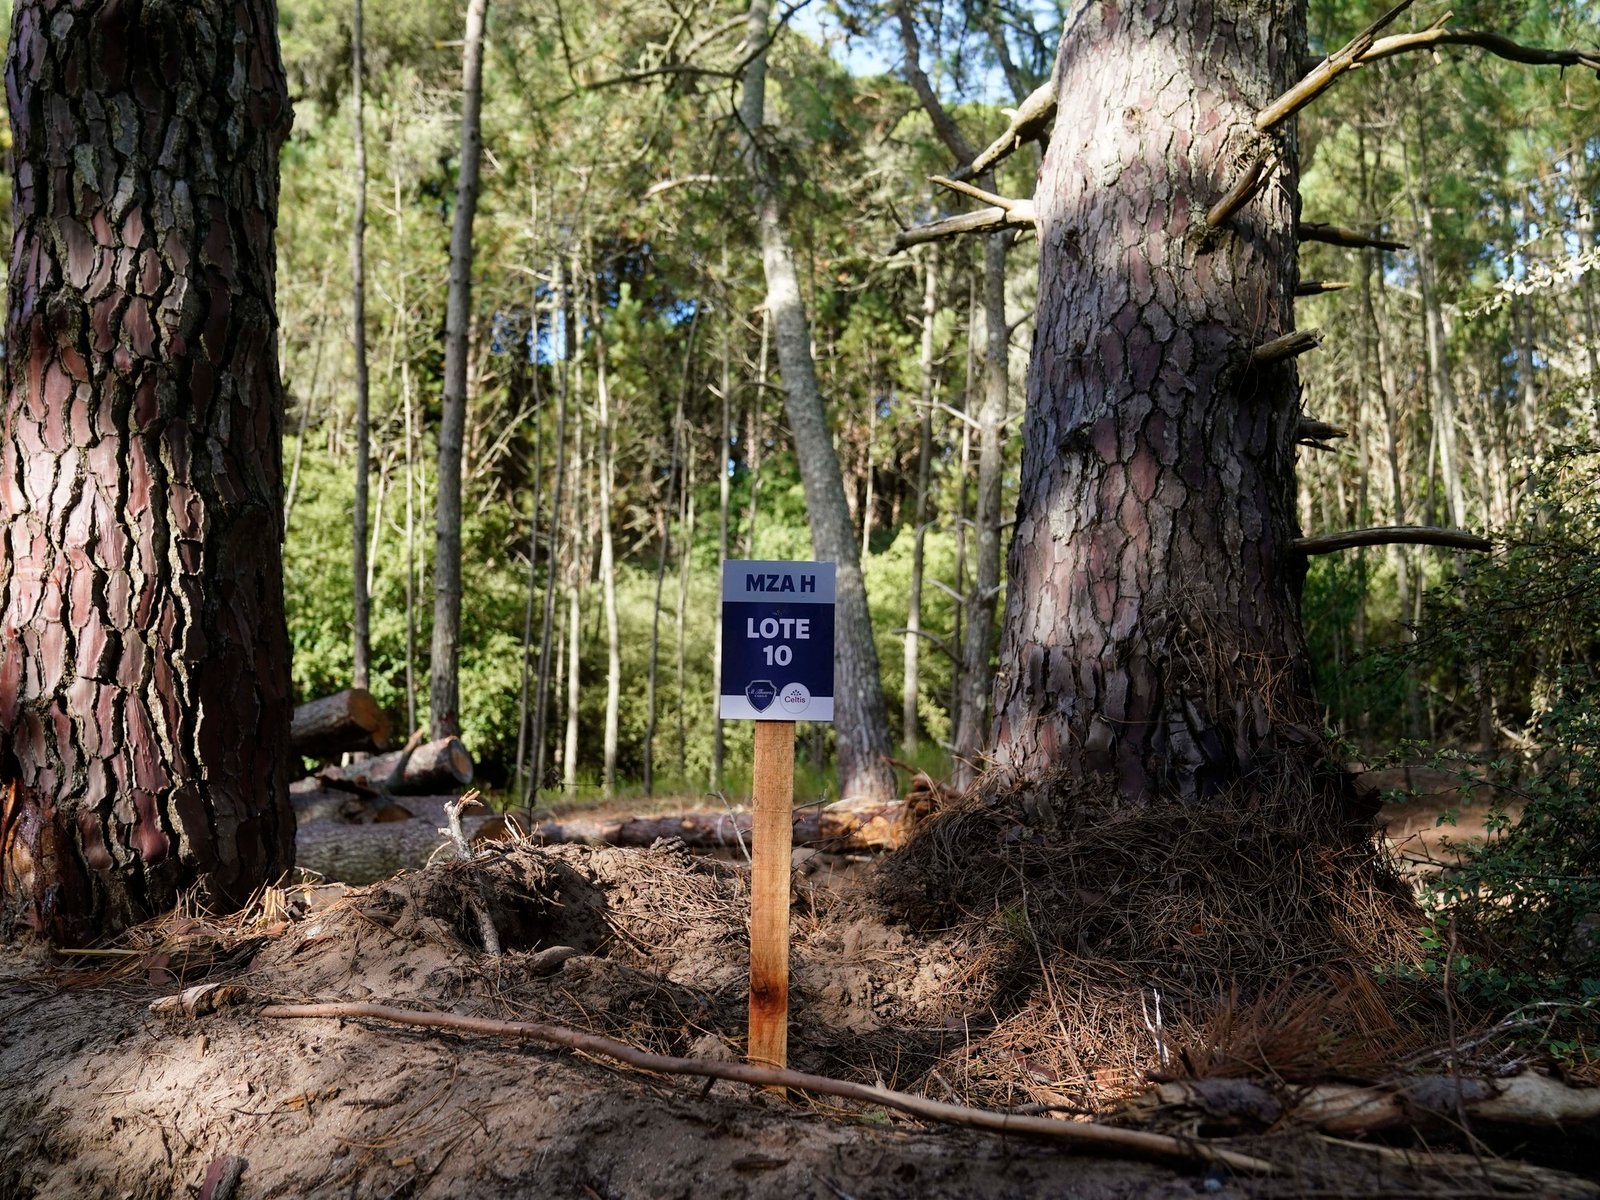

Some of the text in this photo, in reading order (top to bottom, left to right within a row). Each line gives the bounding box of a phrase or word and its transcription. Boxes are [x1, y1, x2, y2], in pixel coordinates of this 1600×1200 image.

[746, 574, 816, 593] MZA H
[747, 617, 810, 640] LOTE
[763, 644, 793, 667] 10
[784, 695, 806, 704] Celtis
